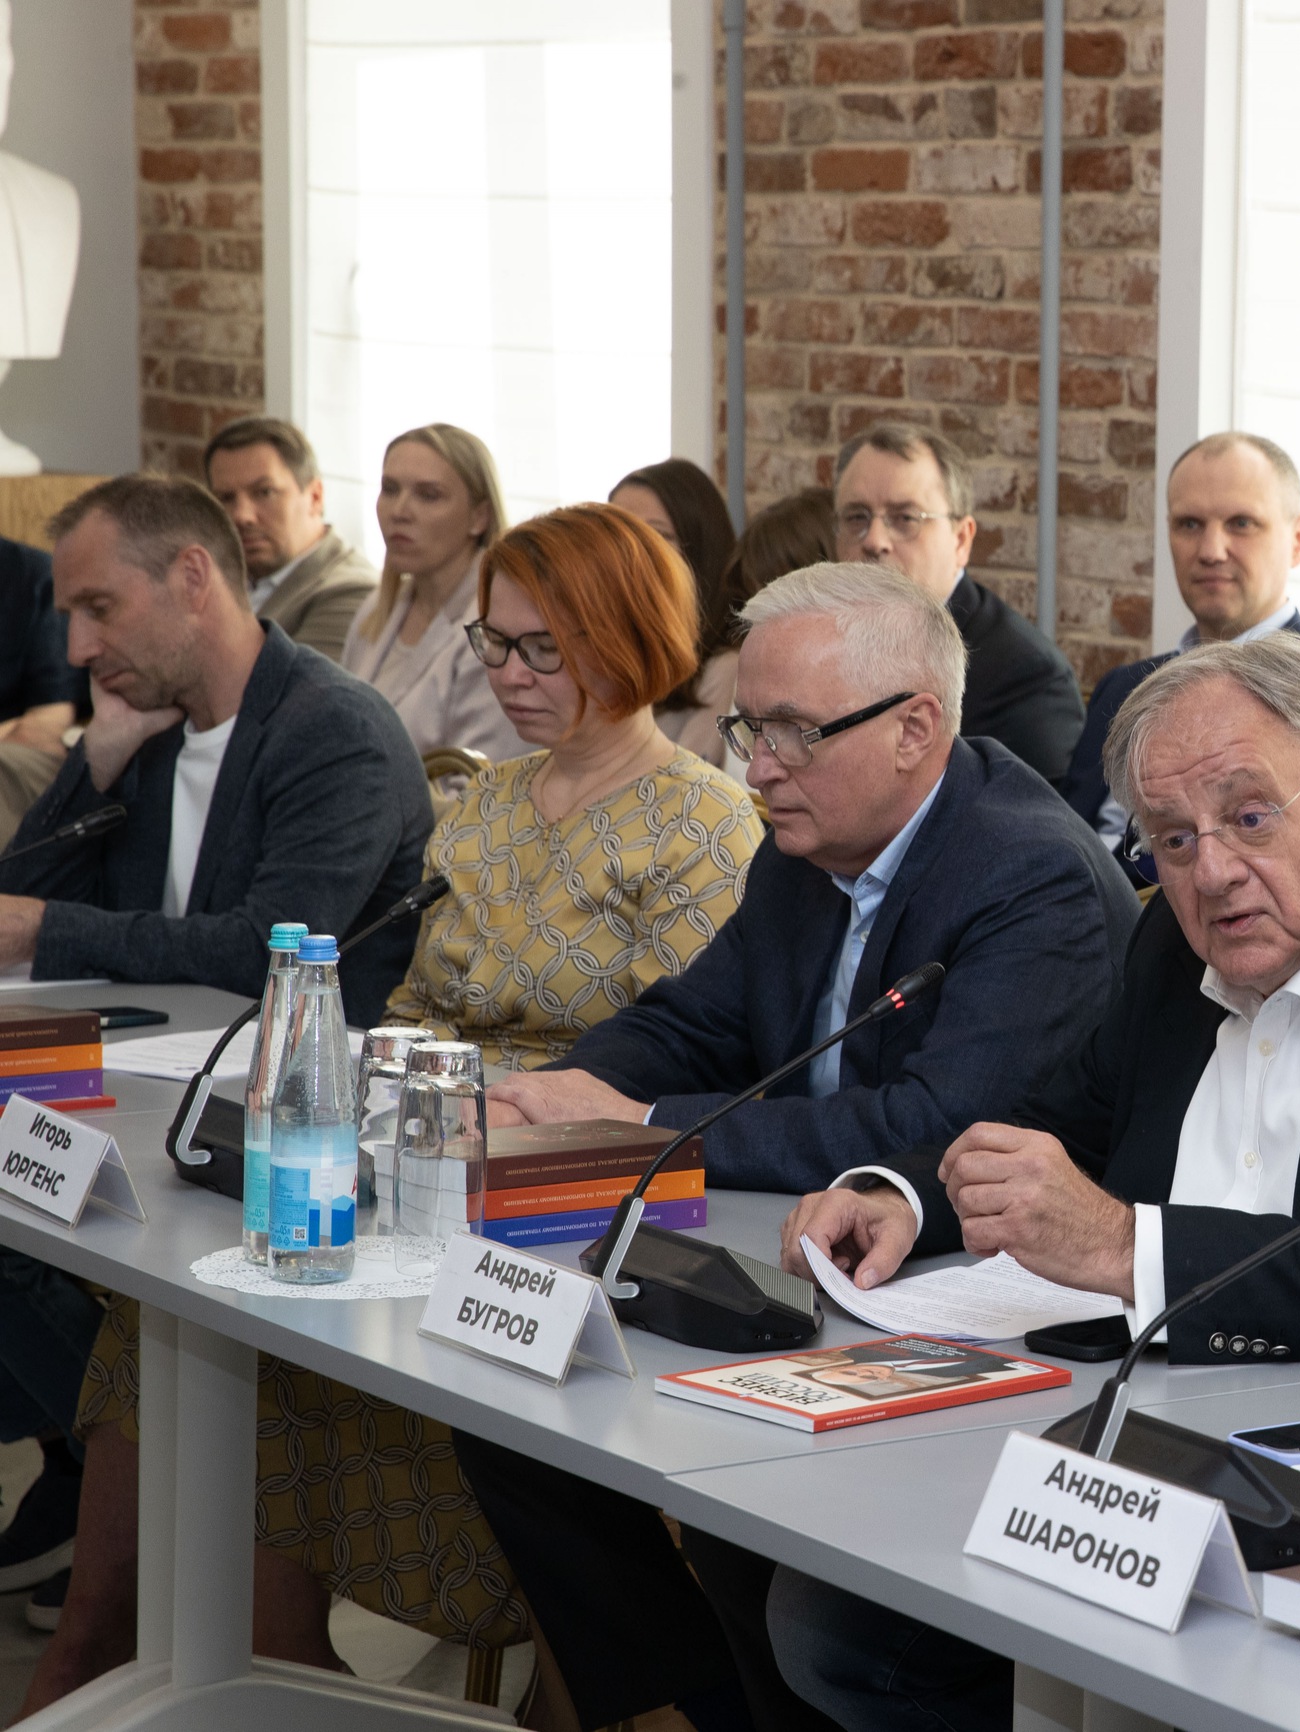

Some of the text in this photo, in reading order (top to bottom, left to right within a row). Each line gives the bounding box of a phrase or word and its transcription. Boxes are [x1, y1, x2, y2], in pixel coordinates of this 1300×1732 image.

[29, 1112, 72, 1151] Игорь
[540, 1161, 588, 1172] КОРПОРАТИВНОМУ
[617, 1154, 657, 1165] АЦИОНАЛЬНЫЙ
[2, 1150, 66, 1197] ЮРГЕНС
[505, 1167, 540, 1176] УПРАВЛЕНИЮ
[503, 1198, 539, 1207] УПРАВЛЕНИЮ
[539, 1193, 587, 1203] КОРПОРАТИВНОМУ
[596, 1189, 617, 1198] ДОКЛАД
[506, 1228, 542, 1237] УПРАВЛЕНИЮ
[541, 1223, 589, 1234] КОРПОРАТИВНОМУ
[473, 1249, 557, 1298] Андрей
[456, 1296, 539, 1346] БУГРОВ
[718, 1376, 824, 1406] БИЗНЕС
[741, 1371, 845, 1402] РОССИИ
[1043, 1459, 1161, 1522] Андрей
[1003, 1507, 1161, 1588] ШАРОНОВ
